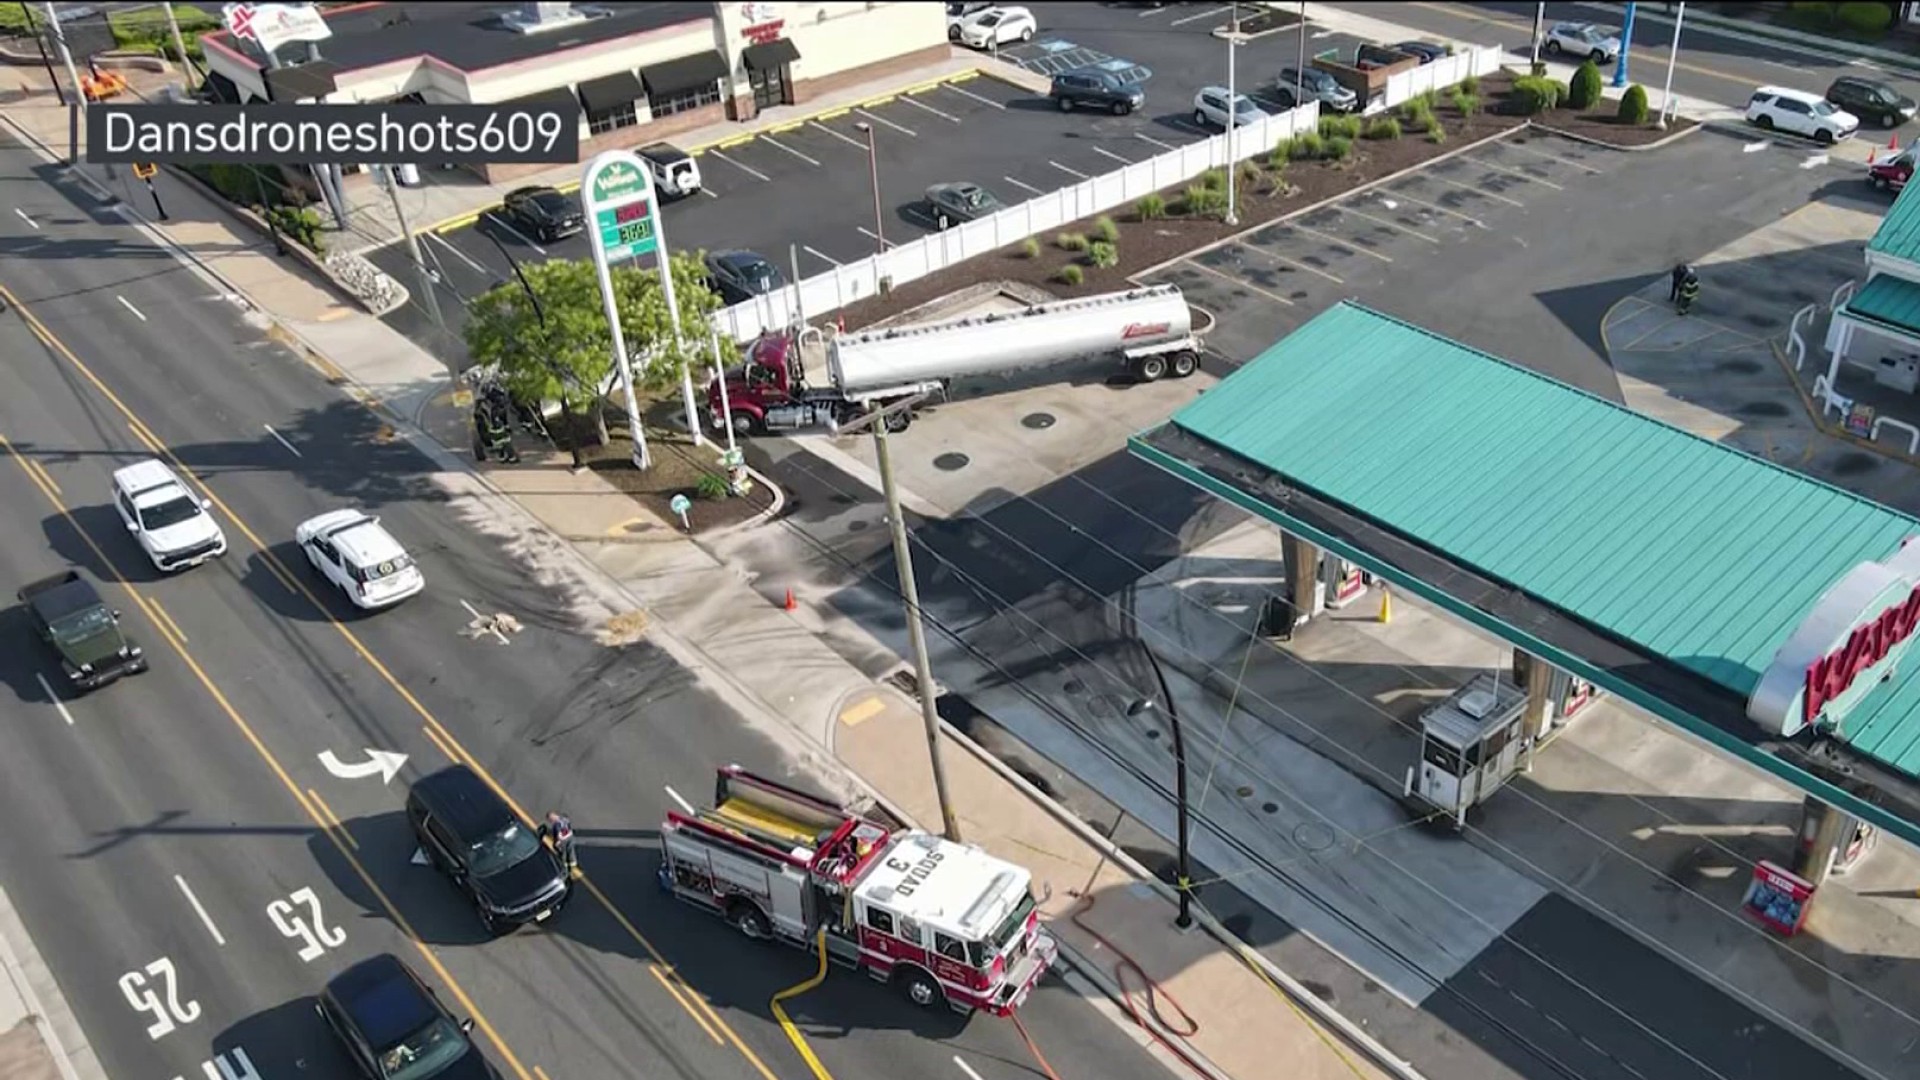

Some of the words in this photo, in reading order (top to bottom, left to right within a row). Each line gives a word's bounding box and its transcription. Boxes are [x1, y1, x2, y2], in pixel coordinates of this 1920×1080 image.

[886, 857, 911, 873] 3
[895, 850, 944, 897] SQUAD
[266, 886, 347, 962] 25
[118, 957, 201, 1040] 25
